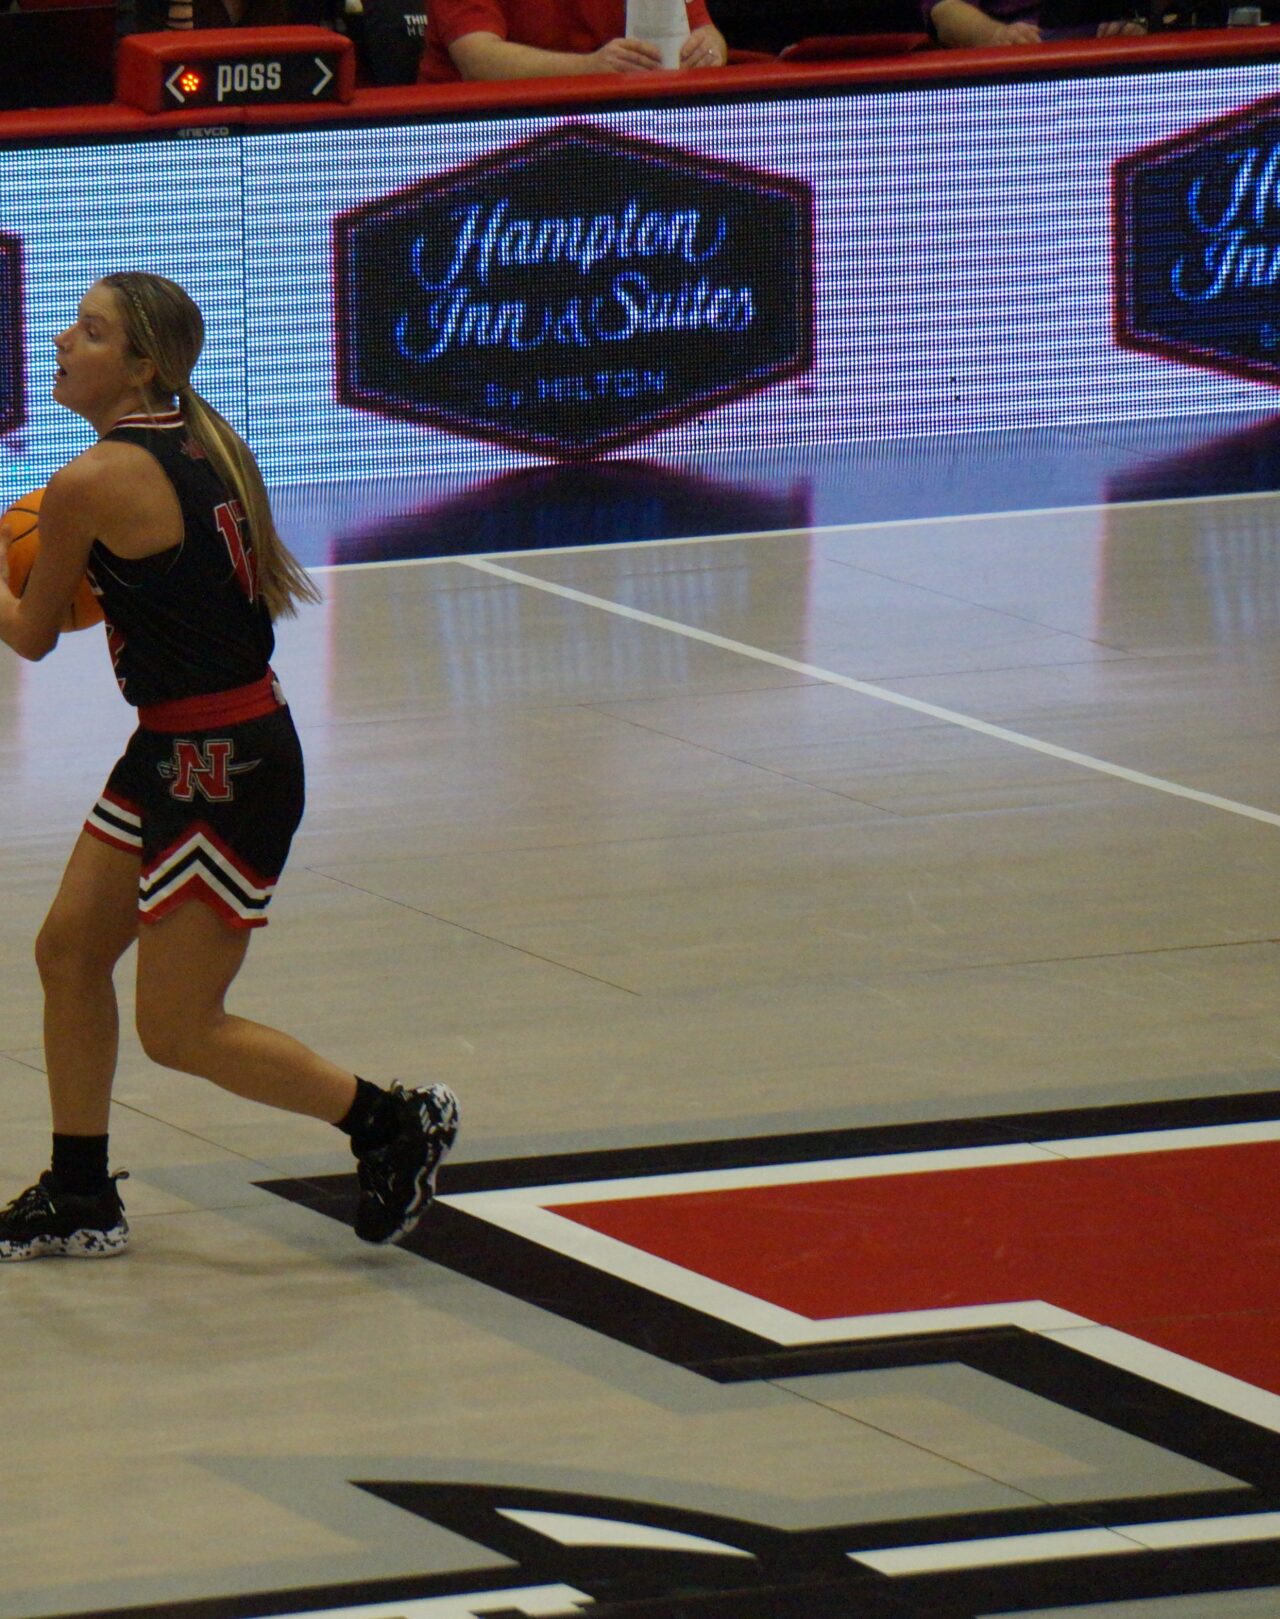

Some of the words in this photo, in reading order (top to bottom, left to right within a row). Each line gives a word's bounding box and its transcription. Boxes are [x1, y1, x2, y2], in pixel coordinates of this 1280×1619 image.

[409, 198, 727, 290] Hampton
[394, 286, 554, 363] Inn
[590, 272, 757, 342] Suites
[537, 369, 666, 403] HILTON
[169, 738, 235, 803] N
